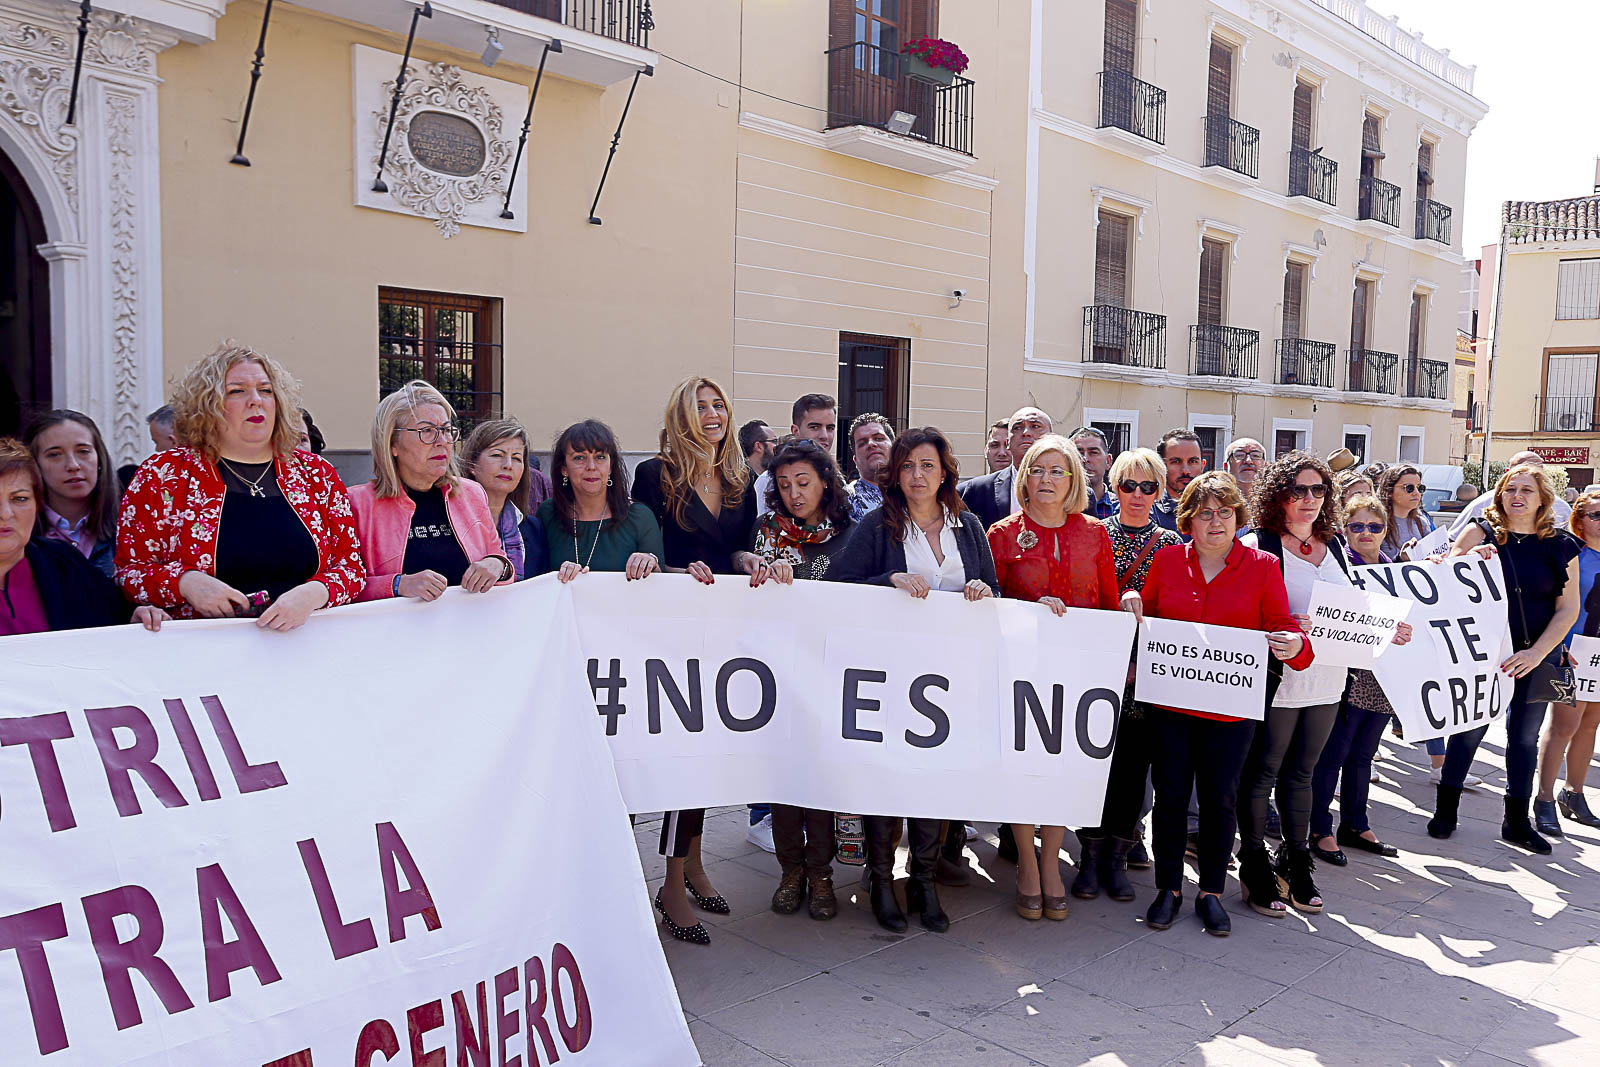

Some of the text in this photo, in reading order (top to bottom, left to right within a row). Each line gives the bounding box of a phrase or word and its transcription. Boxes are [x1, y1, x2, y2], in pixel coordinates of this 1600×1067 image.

[1453, 560, 1502, 604] SI
[1311, 626, 1384, 646] ES VIOLACIÓN
[1315, 605, 1395, 631] #NO ES ABUSO,
[1429, 616, 1488, 664] TE
[1147, 640, 1260, 670] #NO ES ABUSO,
[1151, 662, 1253, 689] ES VIOLACIÓN
[1421, 672, 1501, 730] CREO
[1578, 677, 1597, 693] TE
[587, 657, 1121, 760] #NO ES NO
[0, 695, 288, 832] TRIL
[296, 821, 442, 960] LA
